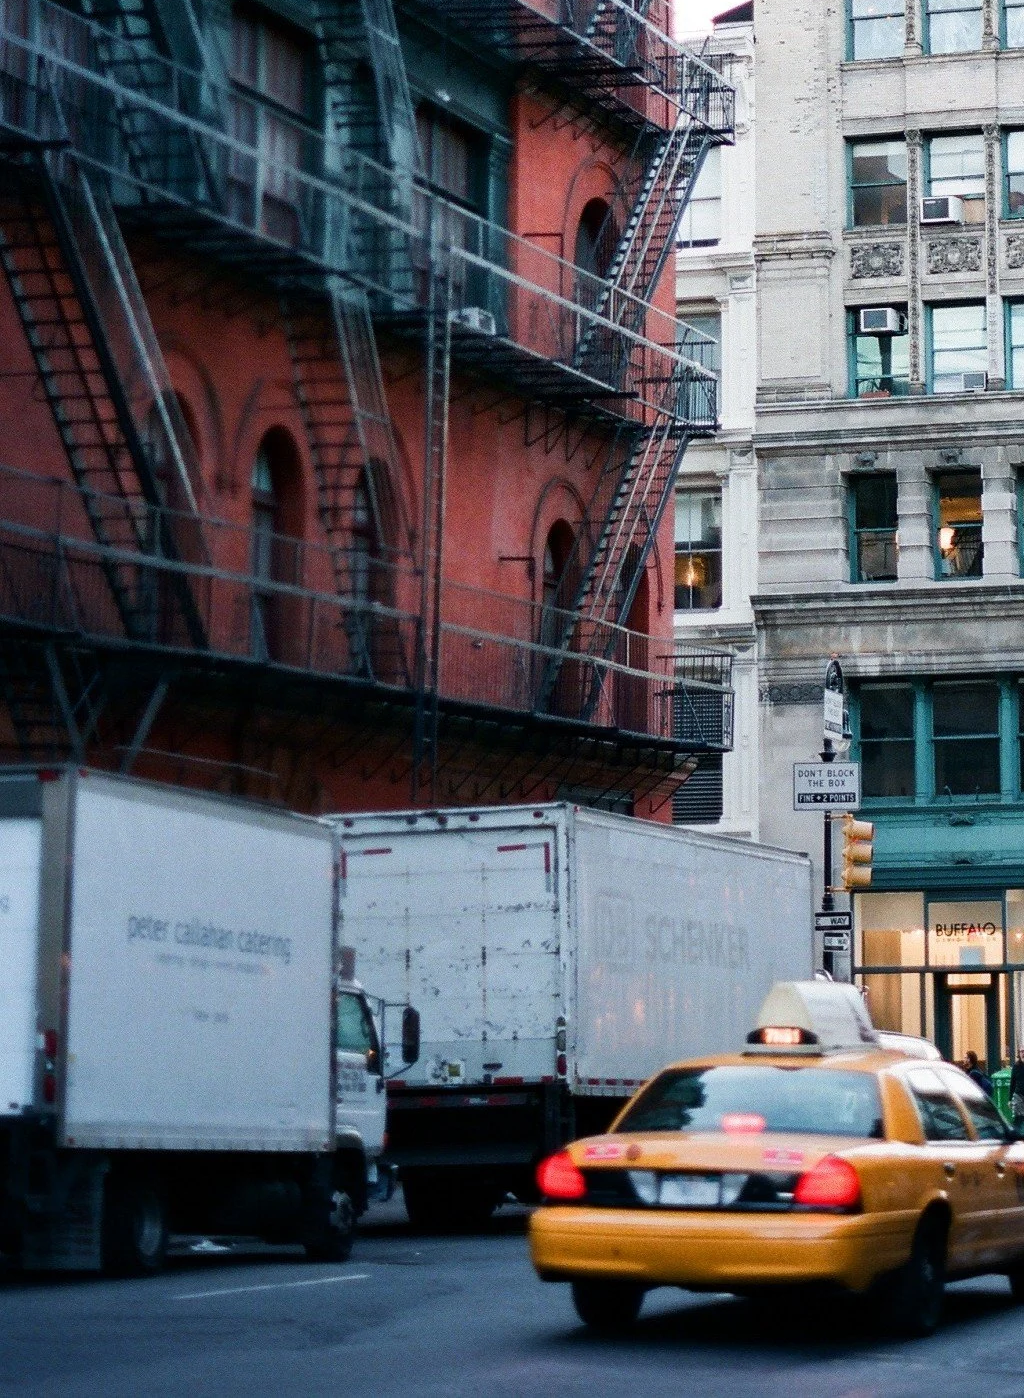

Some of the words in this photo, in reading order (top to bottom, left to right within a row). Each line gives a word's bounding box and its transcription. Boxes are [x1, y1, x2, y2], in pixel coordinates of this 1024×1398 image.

[798, 770, 822, 778] DON'T
[827, 769, 855, 777] BLOCK
[828, 779, 846, 787] BOX
[799, 794, 815, 802] FINE
[829, 794, 854, 802] POINTS
[936, 922, 996, 936] BUFFALO
[127, 915, 169, 943] peter
[237, 929, 292, 965] catering
